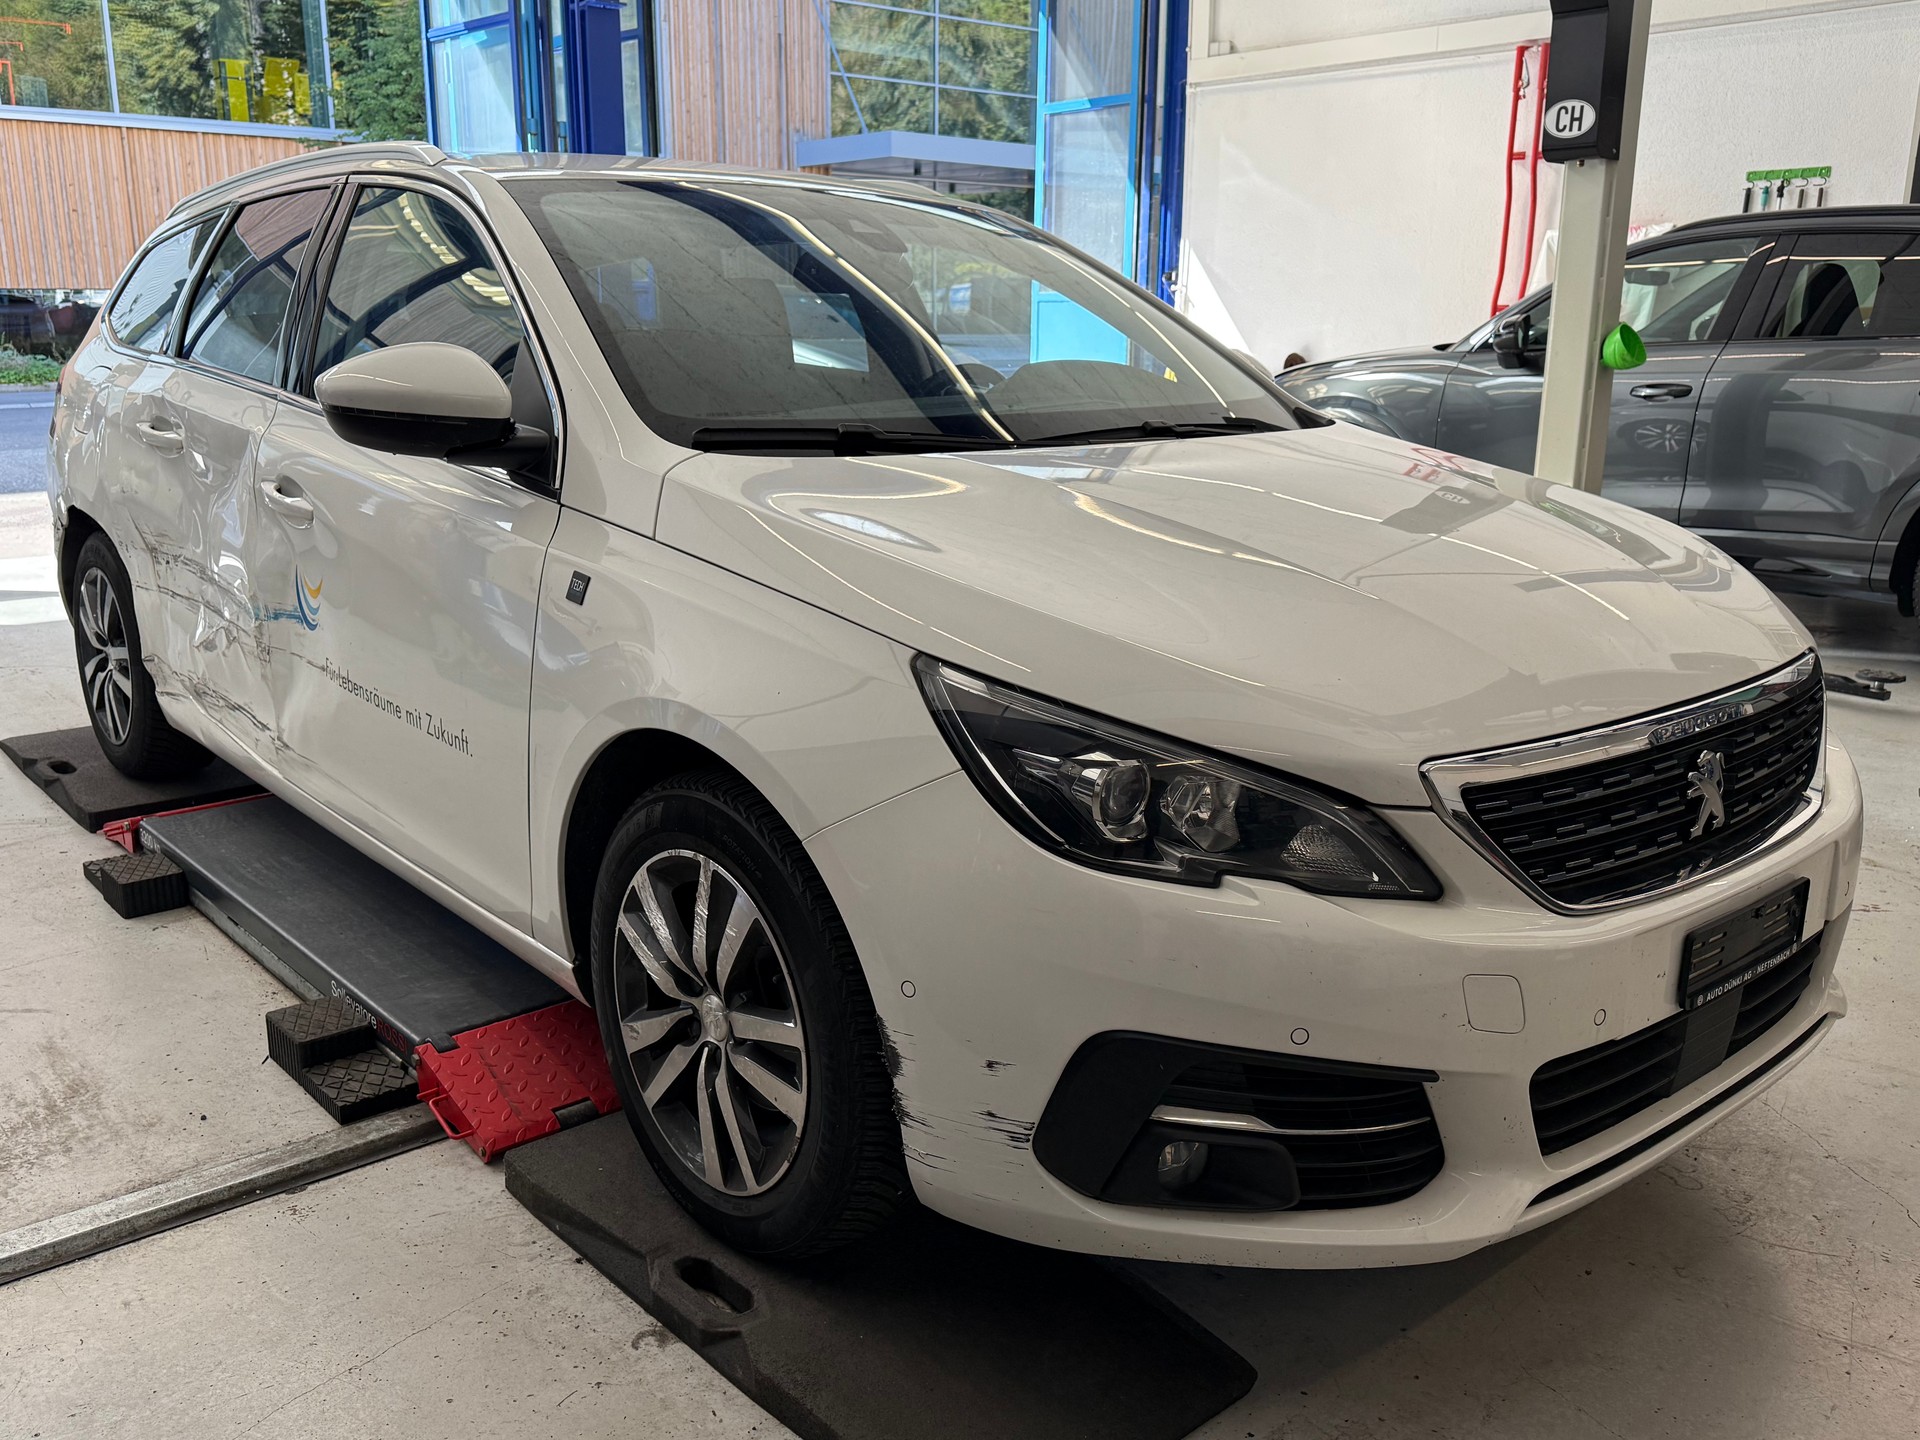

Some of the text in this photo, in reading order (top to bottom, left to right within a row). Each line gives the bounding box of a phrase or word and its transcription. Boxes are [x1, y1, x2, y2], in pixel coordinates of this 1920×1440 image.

[1555, 104, 1585, 133] CH
[571, 577, 586, 593] TECH
[324, 657, 473, 758] Für Lebensräume mit Zukunft.
[1658, 703, 1738, 742] PEUGEOT
[1706, 986, 1723, 1002] AUTO
[1724, 978, 1743, 993] DÜNKI
[1743, 970, 1752, 982] AG
[1756, 948, 1791, 974] NEFTENBACH
[377, 1016, 408, 1057] ROSSI
